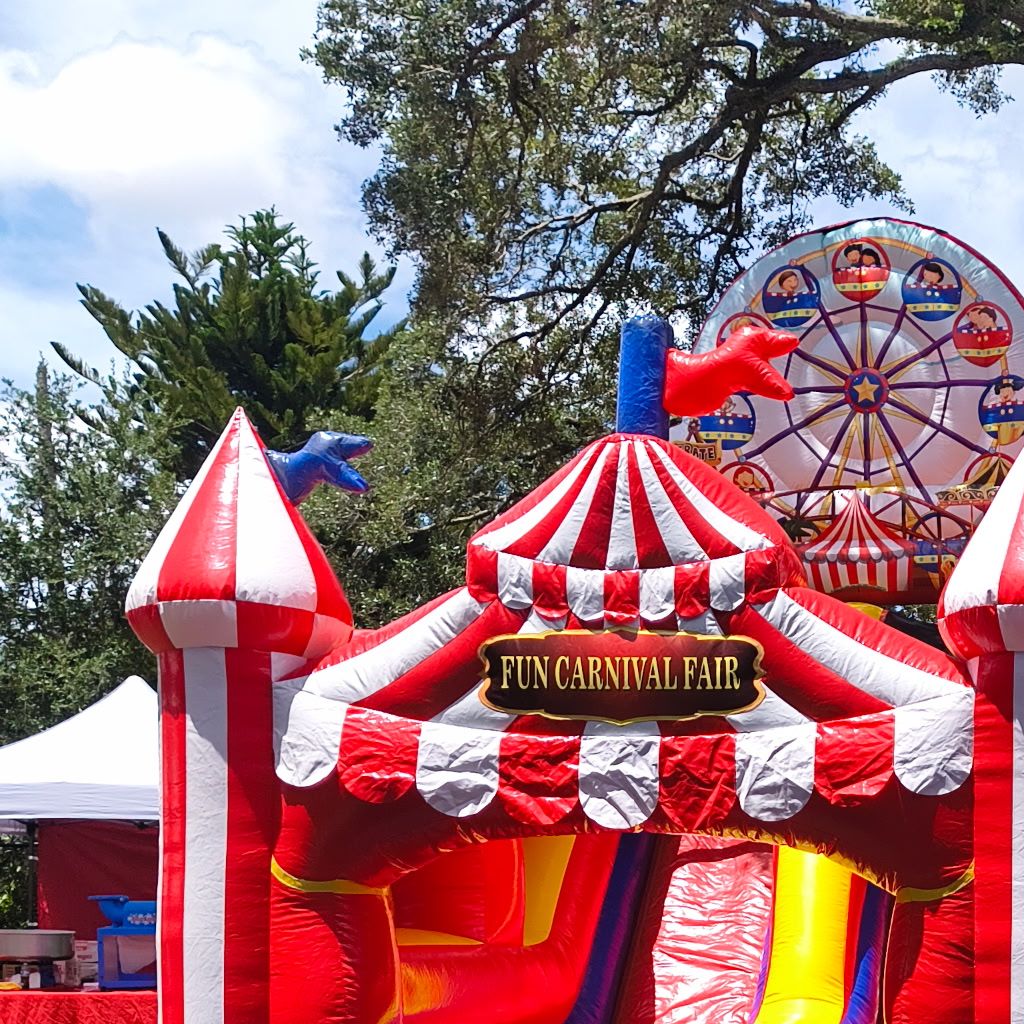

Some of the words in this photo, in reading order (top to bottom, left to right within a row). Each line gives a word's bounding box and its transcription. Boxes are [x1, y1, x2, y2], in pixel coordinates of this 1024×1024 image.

[679, 445, 714, 460] RATE
[500, 655, 550, 690] FUN
[554, 655, 677, 691] CARNIVAL
[683, 655, 741, 690] FAIR
